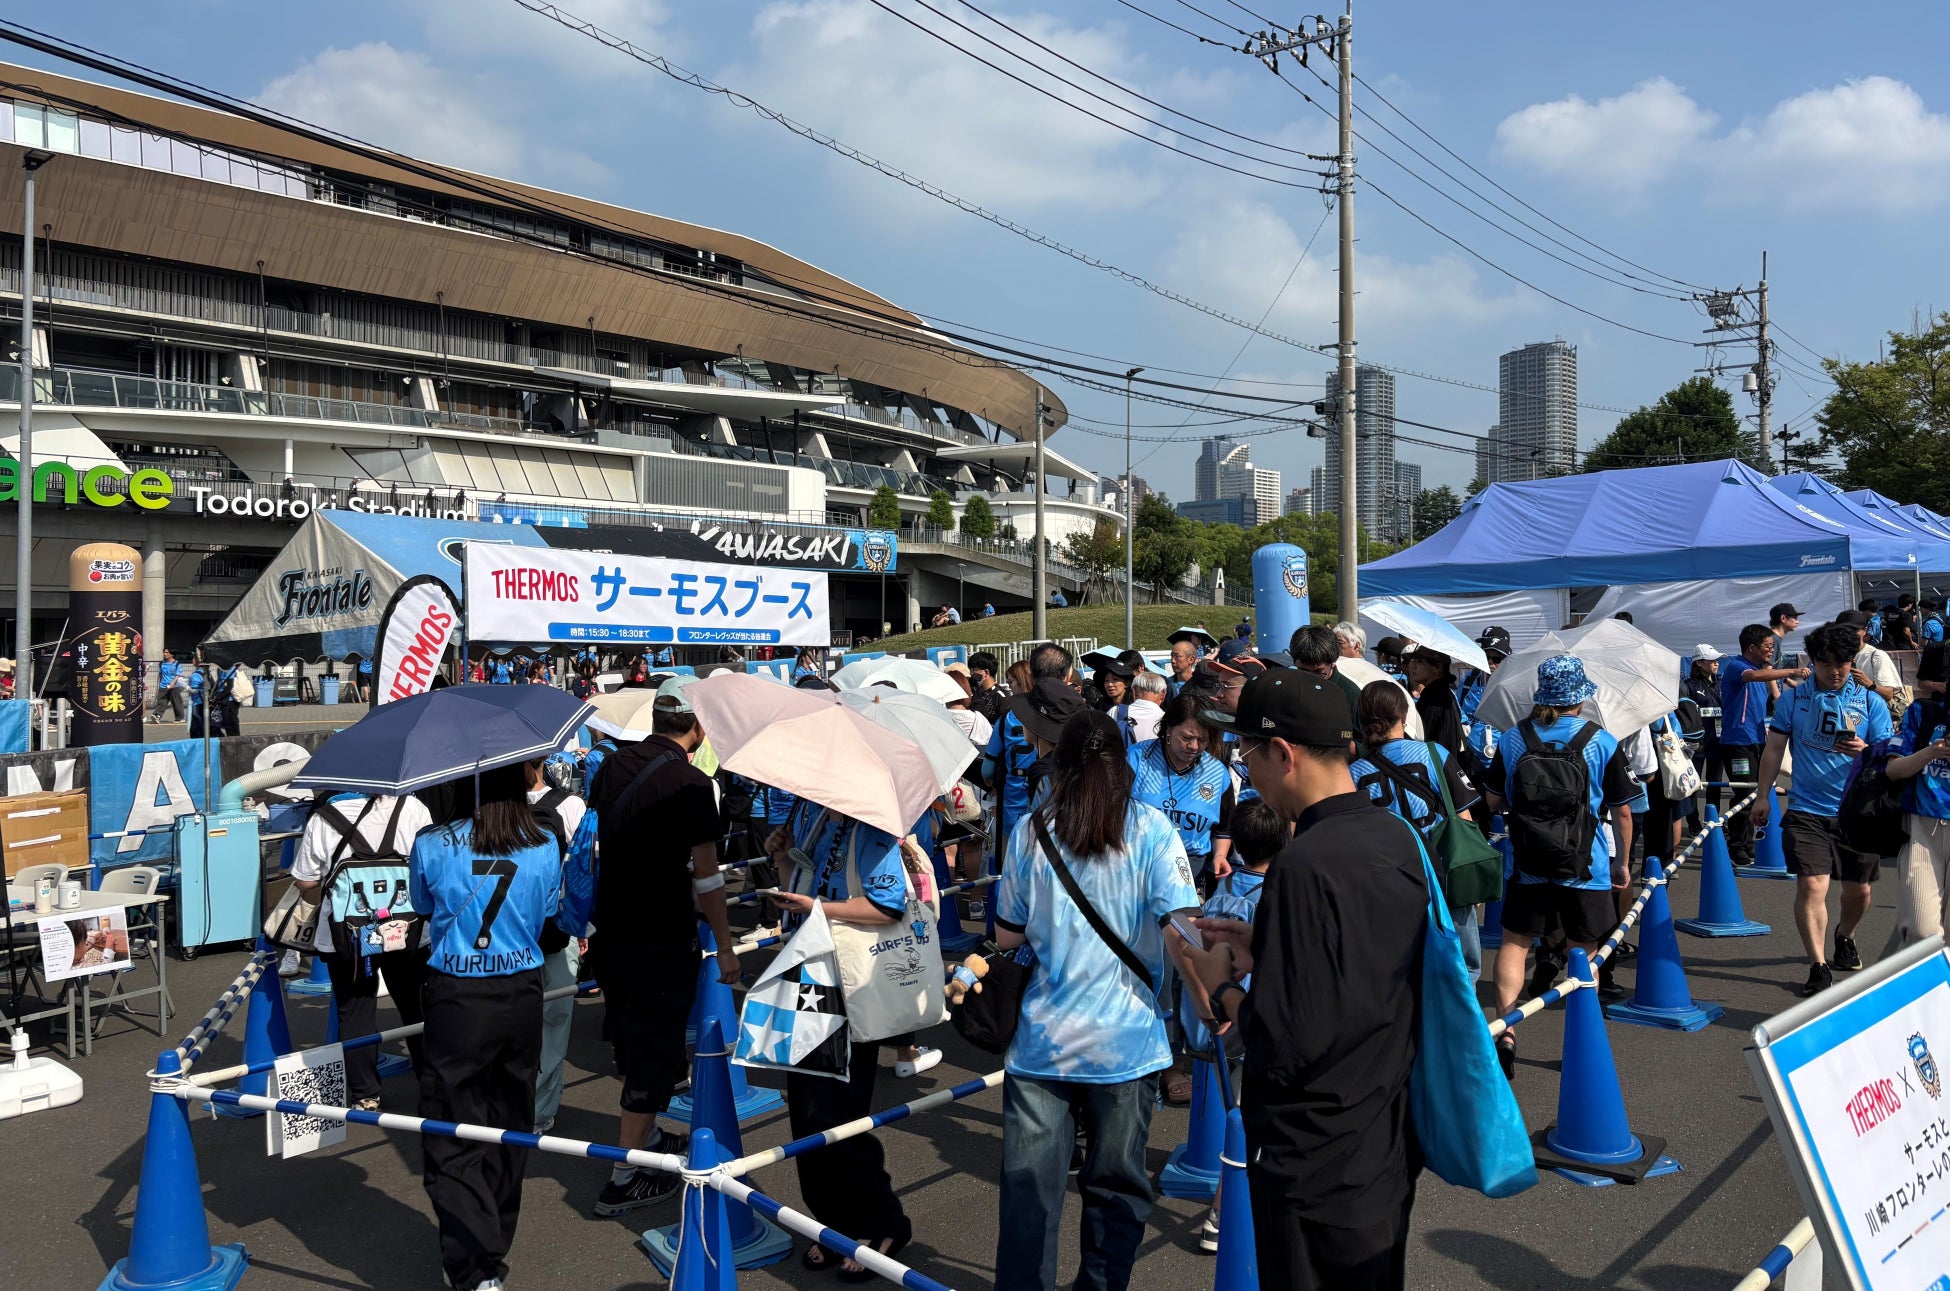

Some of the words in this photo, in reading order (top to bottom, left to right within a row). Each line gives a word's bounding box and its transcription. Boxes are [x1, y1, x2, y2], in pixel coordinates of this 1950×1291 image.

[491, 568, 579, 603] THERMOS
[590, 565, 814, 621] サーモスブース
[1215, 567, 1225, 589] A
[276, 569, 374, 628] Frontale
[77, 642, 89, 669] 中辛
[93, 632, 132, 712] 黄金の味
[952, 787, 965, 809] 2
[868, 874, 899, 890] エバラ
[471, 859, 519, 949] 7
[294, 925, 314, 943] 19
[868, 935, 913, 957] SURF'S
[443, 947, 536, 974] KURUMAYA
[1845, 1077, 1902, 1138] THERMOS
[1904, 1116, 1949, 1166] サーモスと
[1864, 1146, 1950, 1238] 川崎フロンターレの
